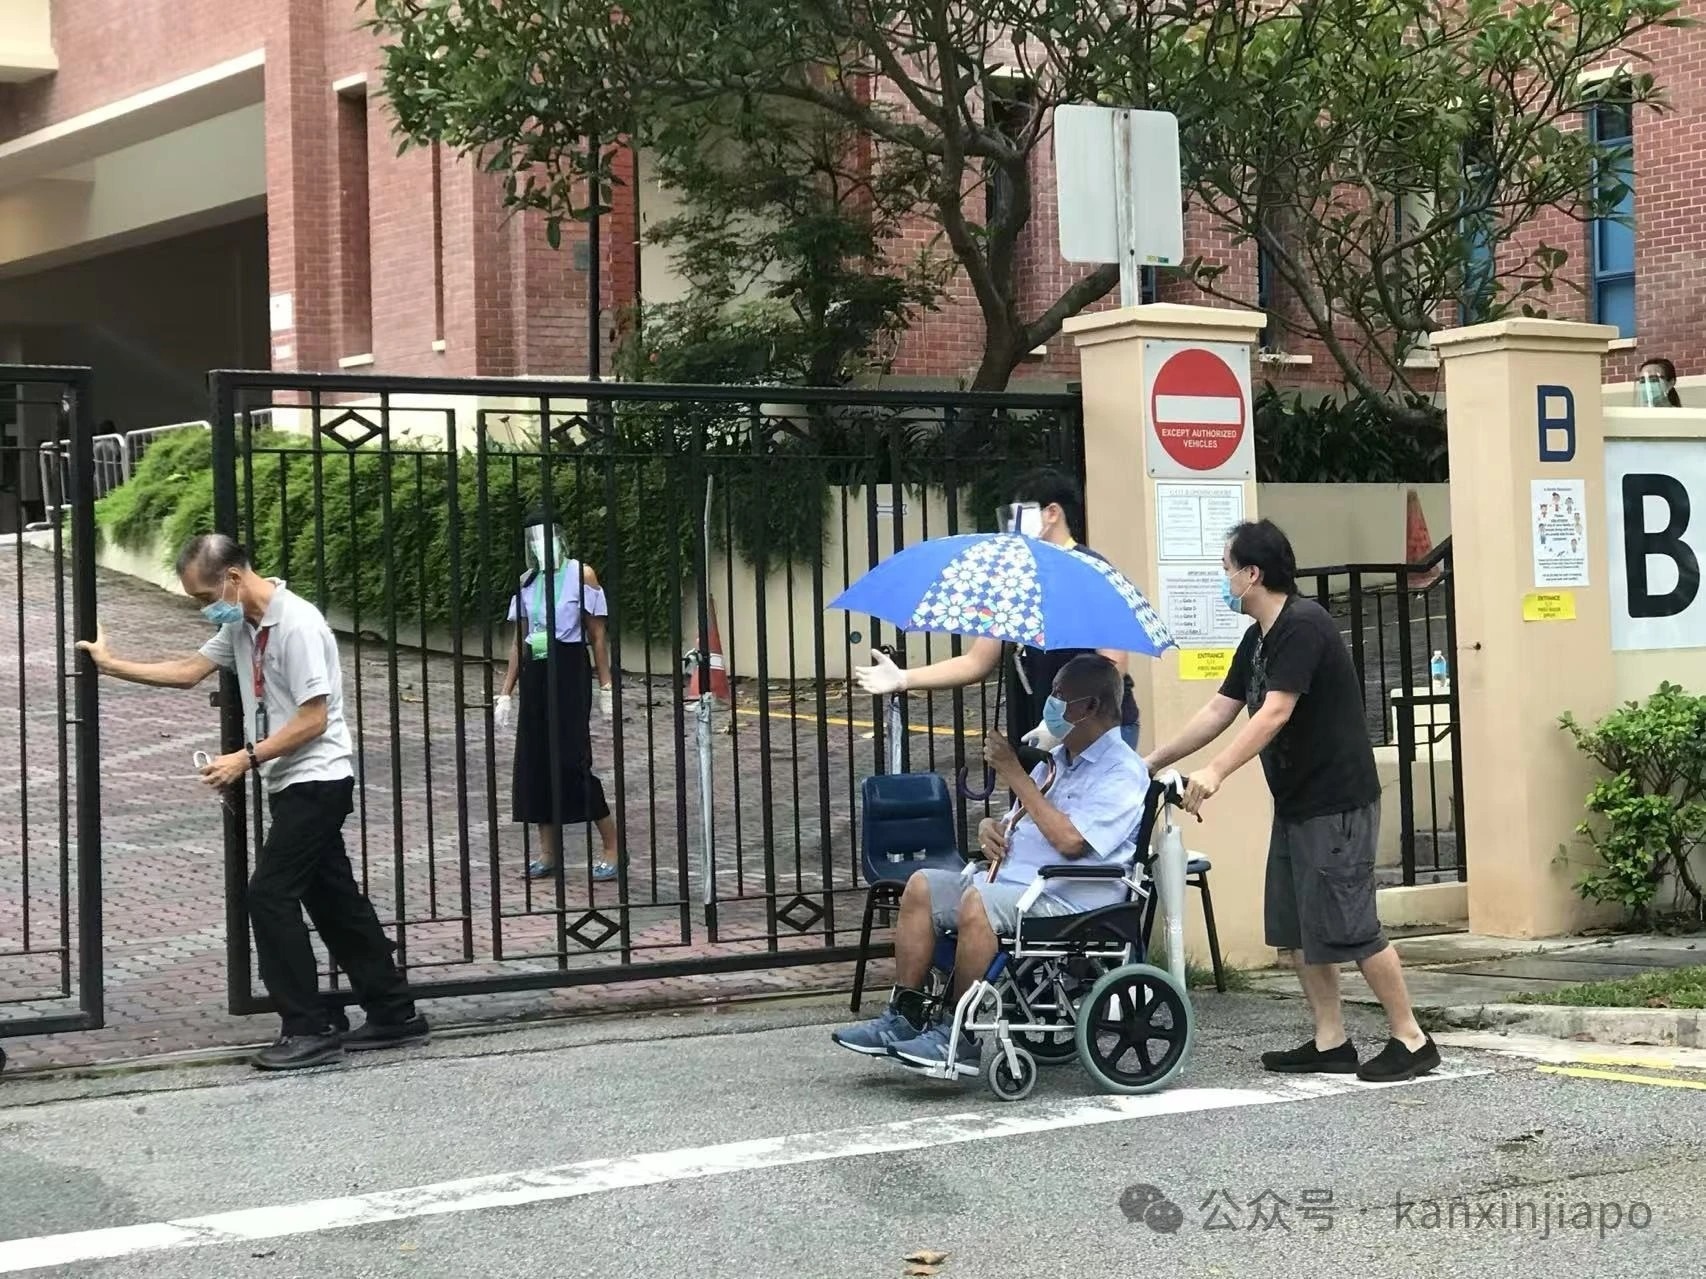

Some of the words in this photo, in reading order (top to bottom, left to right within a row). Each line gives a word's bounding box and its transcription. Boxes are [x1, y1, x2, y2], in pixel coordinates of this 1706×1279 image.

[1161, 428, 1190, 437] EXCEPT
[1191, 429, 1237, 439] AUTHORIZED
[1183, 440, 1218, 449] VEHICLES
[1537, 385, 1576, 462] B
[1622, 473, 1701, 618] B
